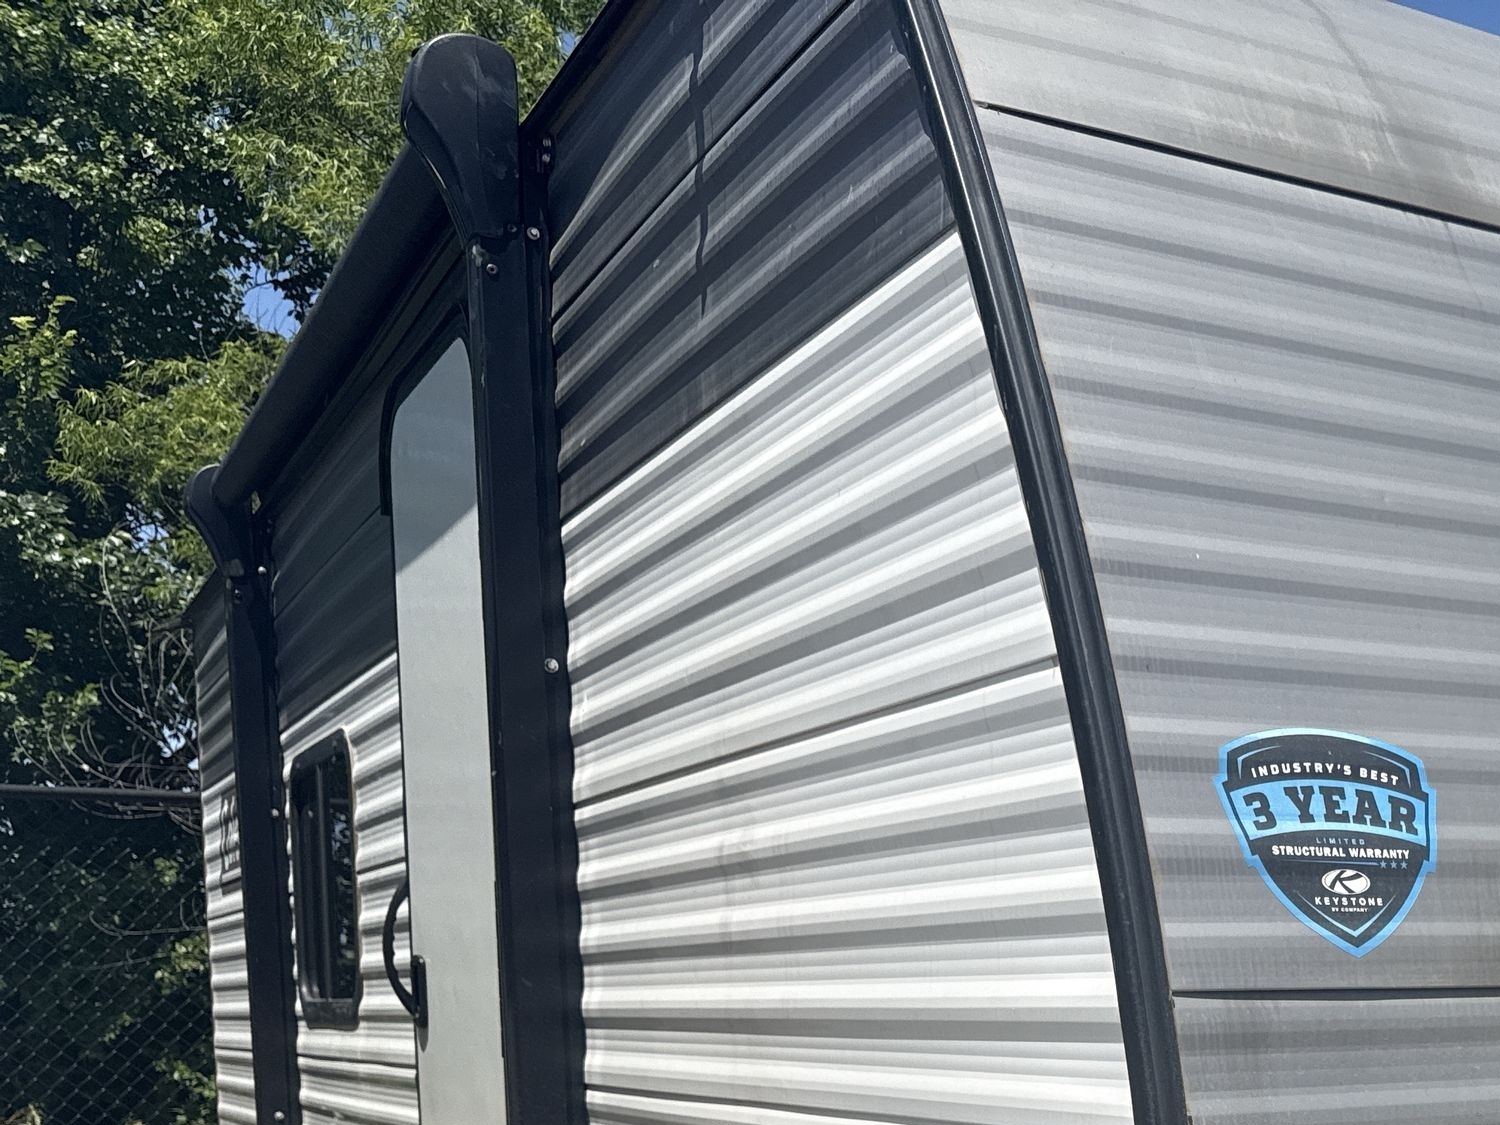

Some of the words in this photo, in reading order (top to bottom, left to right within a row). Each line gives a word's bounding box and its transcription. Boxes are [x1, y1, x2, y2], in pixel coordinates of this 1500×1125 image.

[1251, 762, 1352, 779] INDUSTRY'S
[1359, 768, 1399, 786] BEST
[1242, 791, 1278, 831] 3
[1283, 784, 1419, 837] YEAR
[1316, 837, 1365, 845] LIMITED
[1271, 845, 1347, 858] STRUCTURAL
[1348, 847, 1410, 860] WARRANTY
[1314, 896, 1384, 907] KEYSTONE
